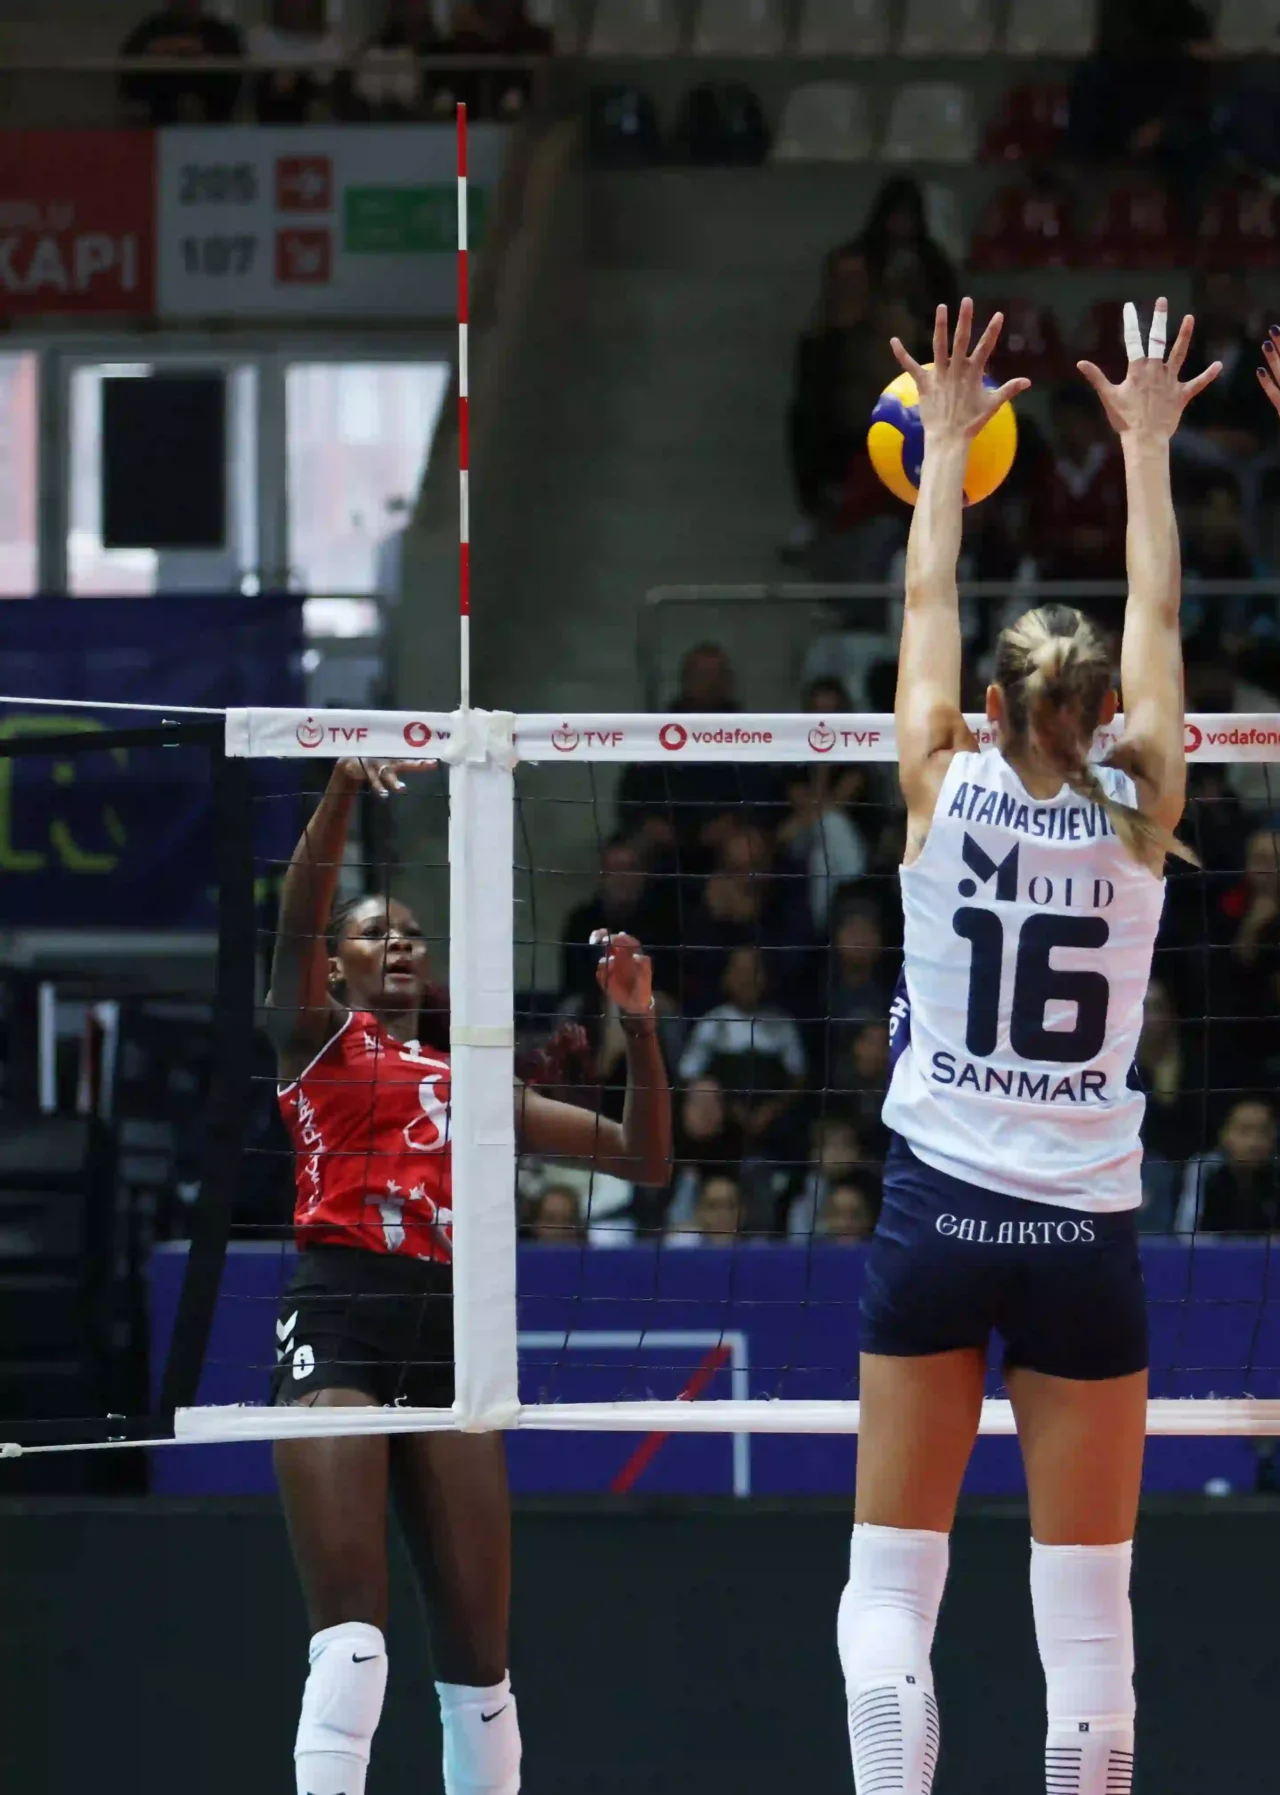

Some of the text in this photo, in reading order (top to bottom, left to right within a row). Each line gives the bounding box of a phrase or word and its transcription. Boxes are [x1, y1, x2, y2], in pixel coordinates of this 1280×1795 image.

[328, 727, 368, 742] TVF
[584, 731, 623, 747] TVF
[692, 728, 772, 744] vodafone
[841, 731, 880, 747] TVF
[952, 906, 1109, 1063] 16
[931, 1051, 1109, 1102] SANMAR
[935, 1212, 1096, 1245] GALAKTOS
